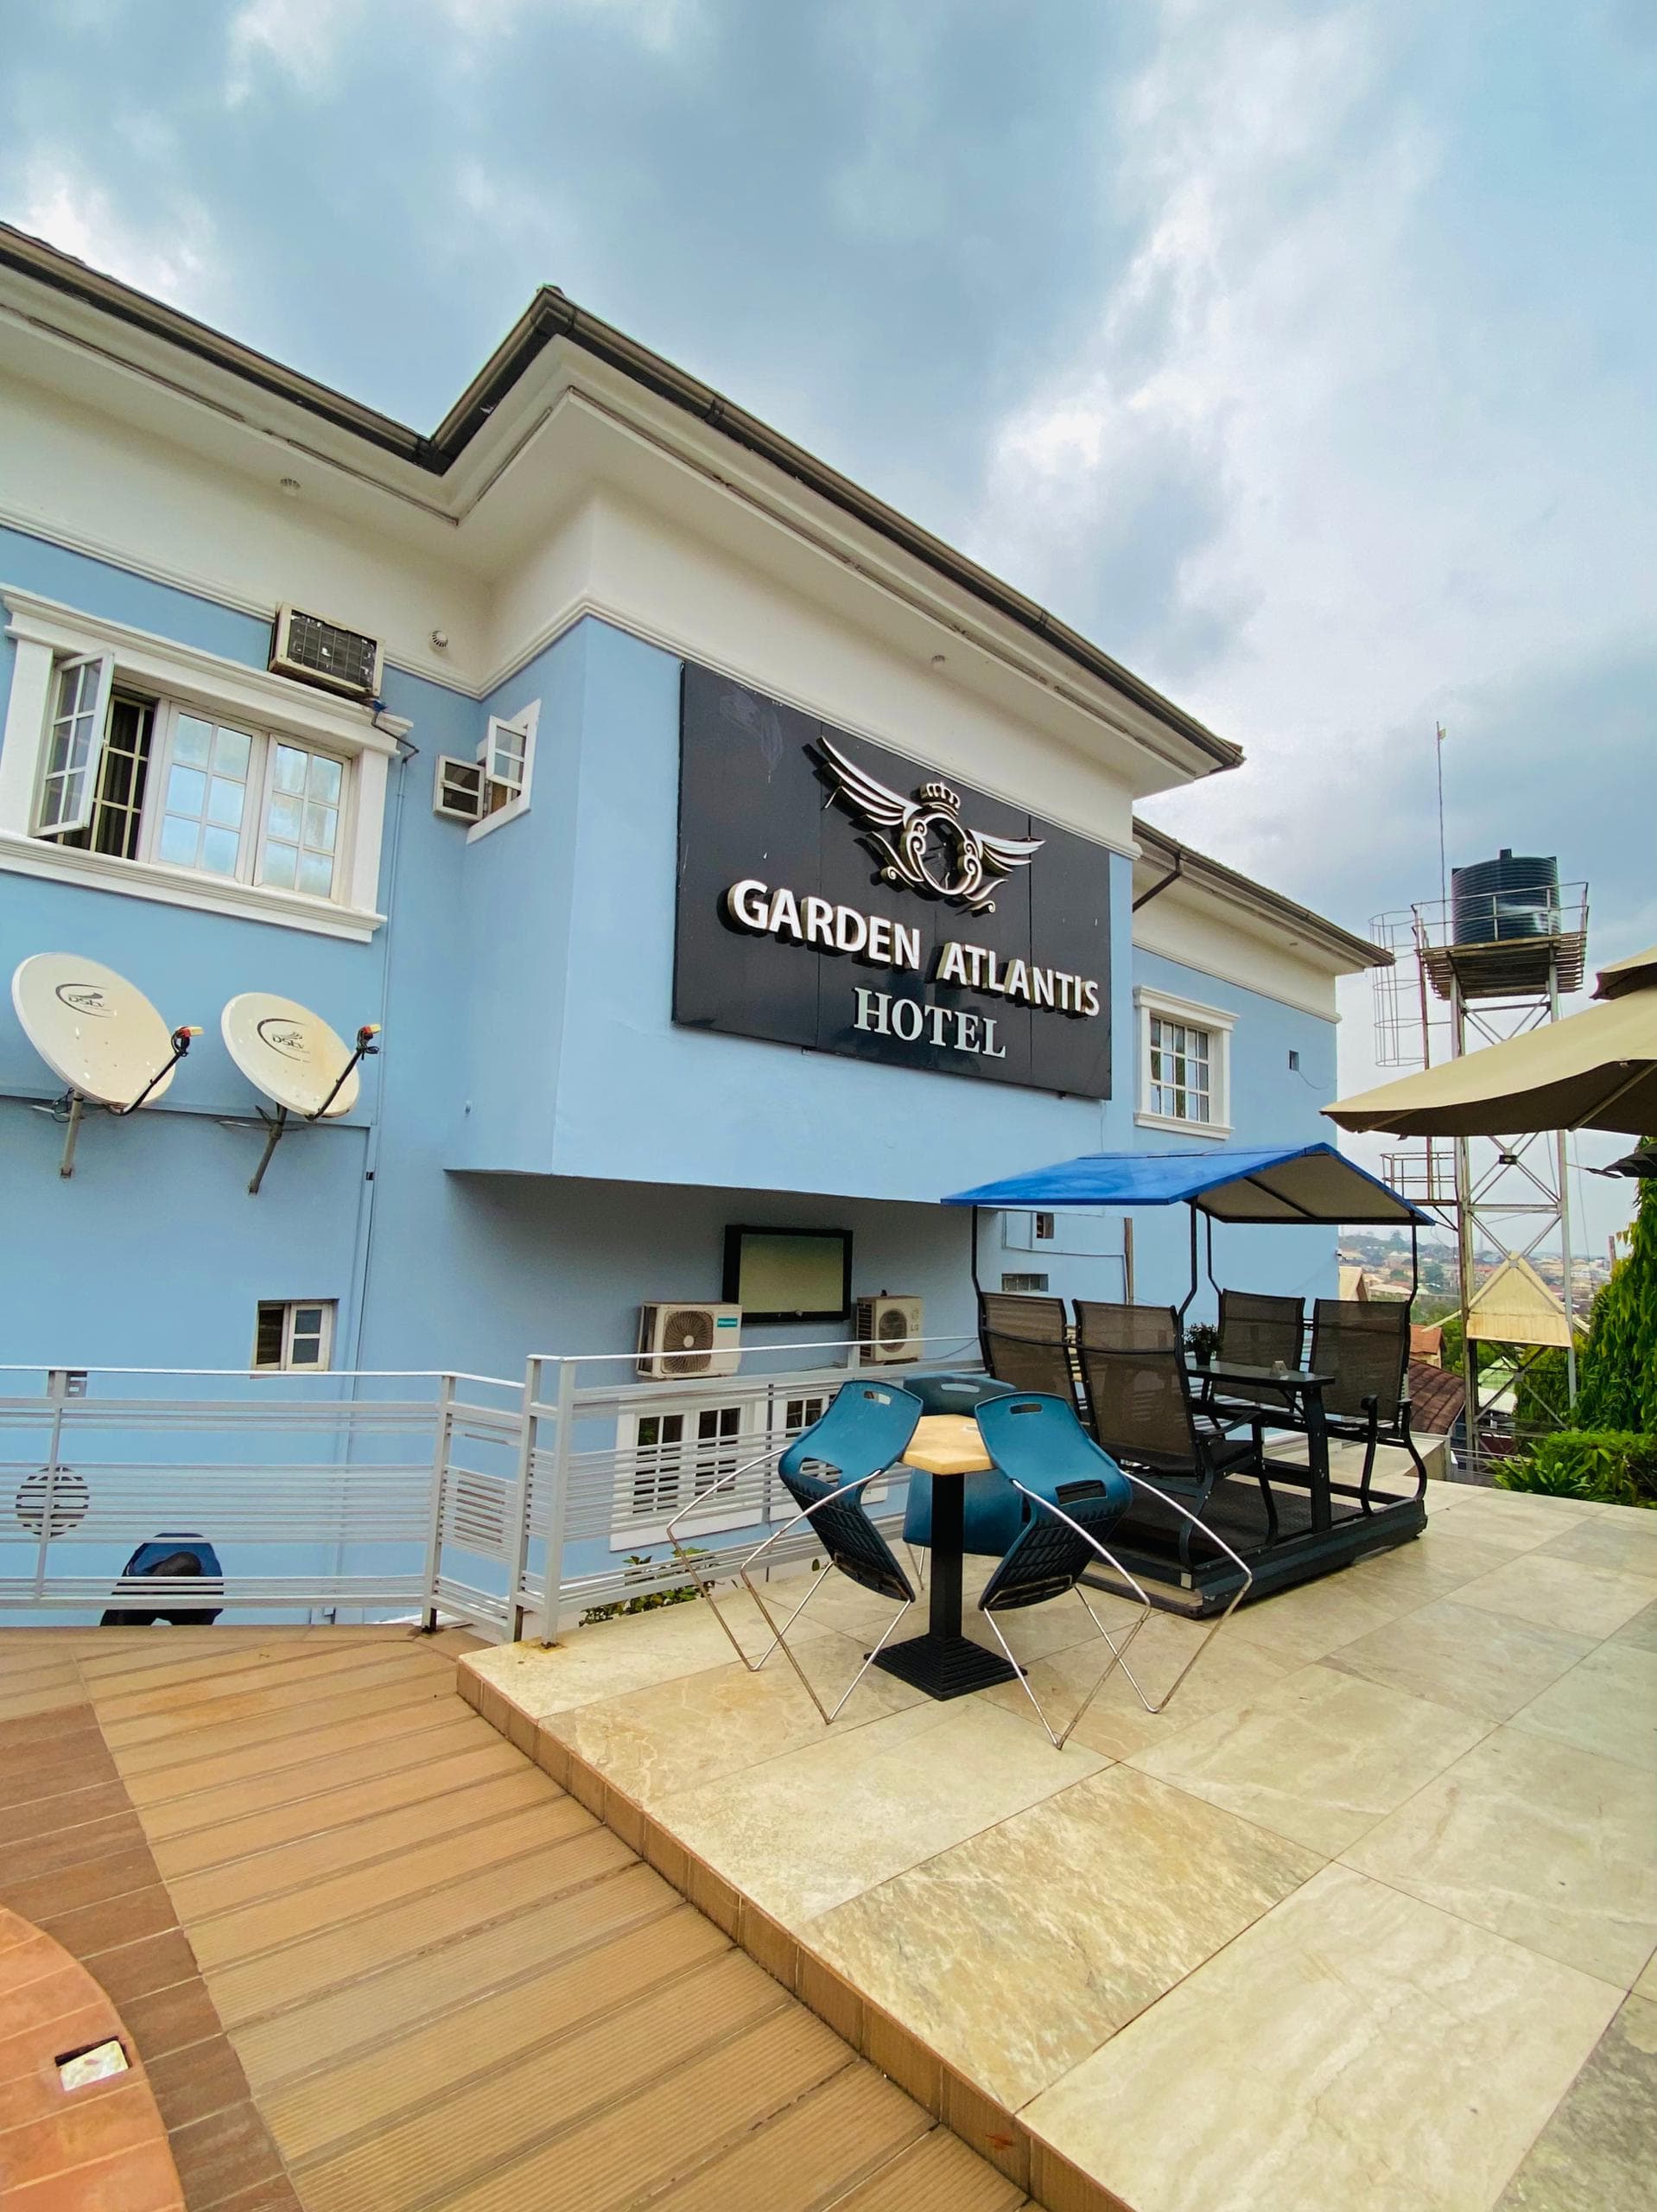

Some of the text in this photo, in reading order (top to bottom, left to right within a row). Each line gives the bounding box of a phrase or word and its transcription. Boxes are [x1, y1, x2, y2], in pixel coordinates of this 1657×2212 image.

[731, 879, 1100, 1017] GARDEN ATLANTIS
[853, 987, 1006, 1058] HOTEL
